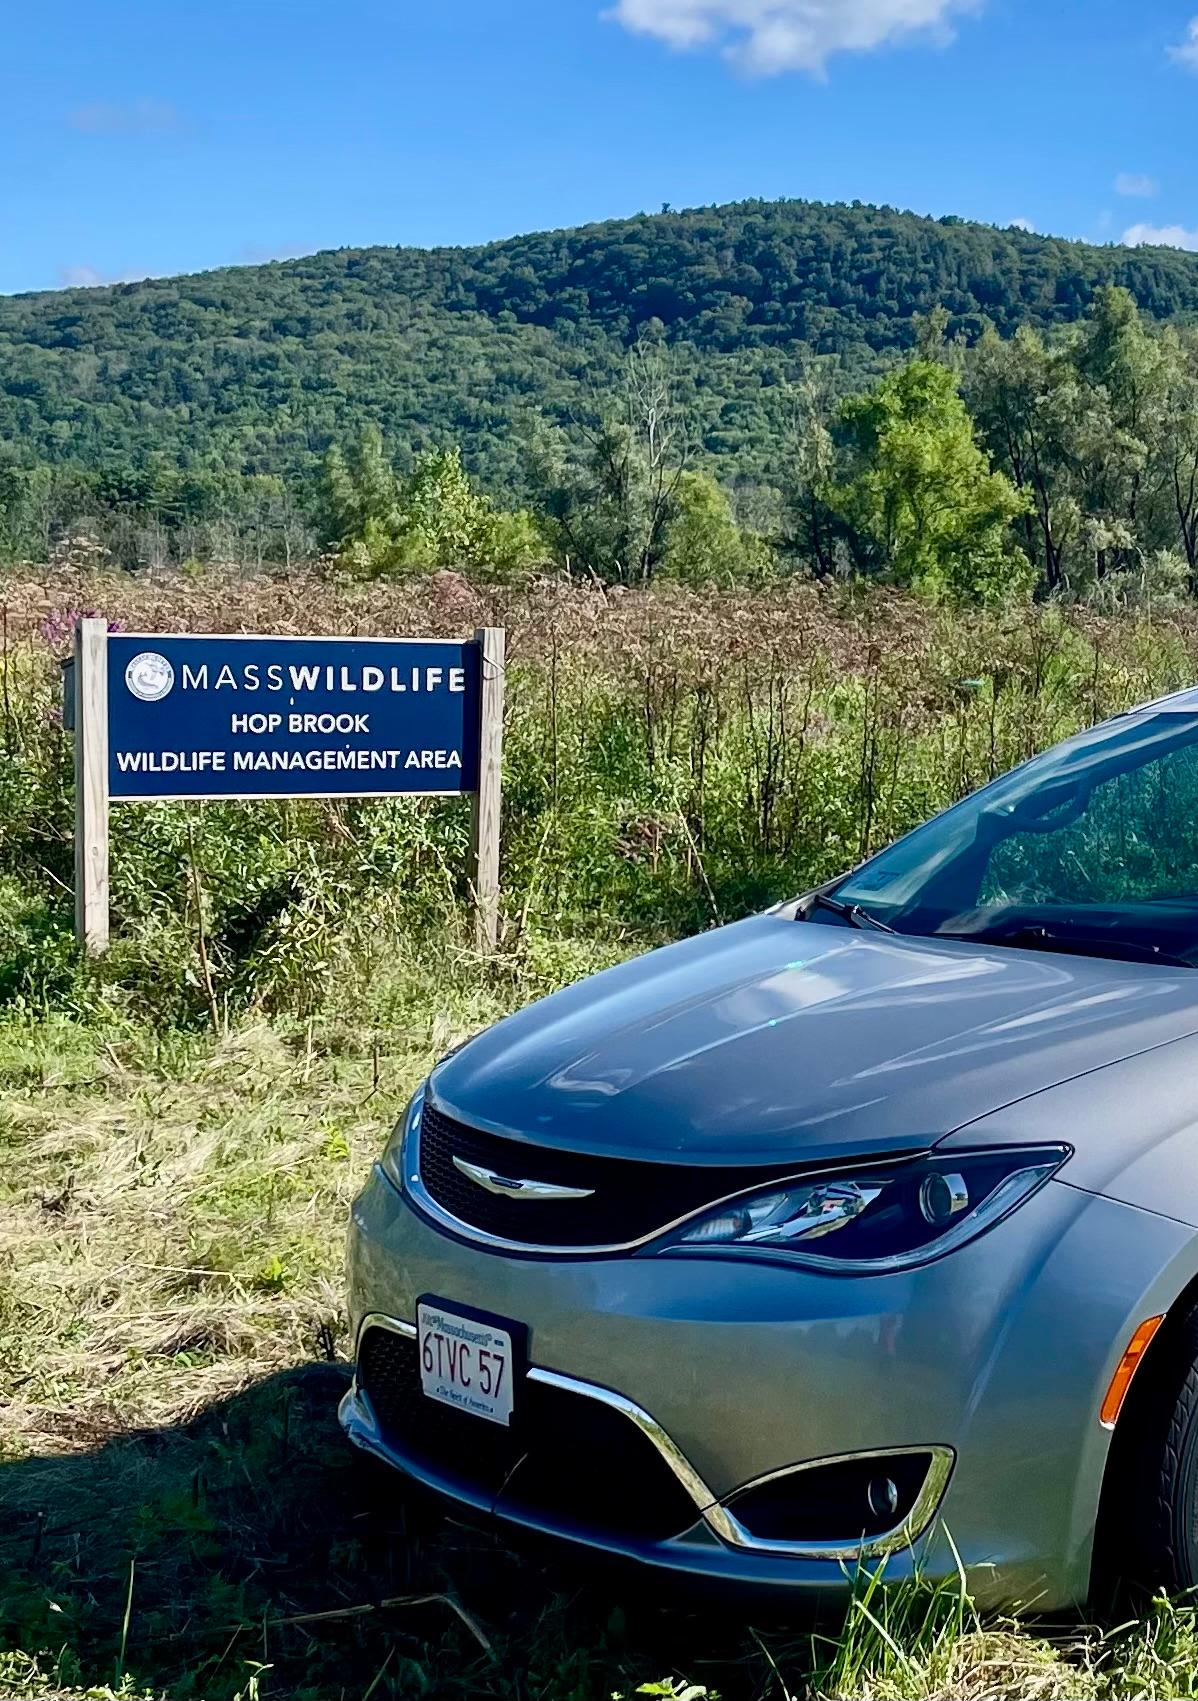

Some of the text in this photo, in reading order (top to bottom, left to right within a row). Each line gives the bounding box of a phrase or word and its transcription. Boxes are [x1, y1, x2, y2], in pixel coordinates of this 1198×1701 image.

[182, 664, 465, 692] MASSWILDLIFE
[231, 713, 370, 734] HOP BROOK
[116, 750, 463, 772] WILDLIFE MANAGEMENT AREA
[423, 1331, 505, 1399] 6TVC 57
